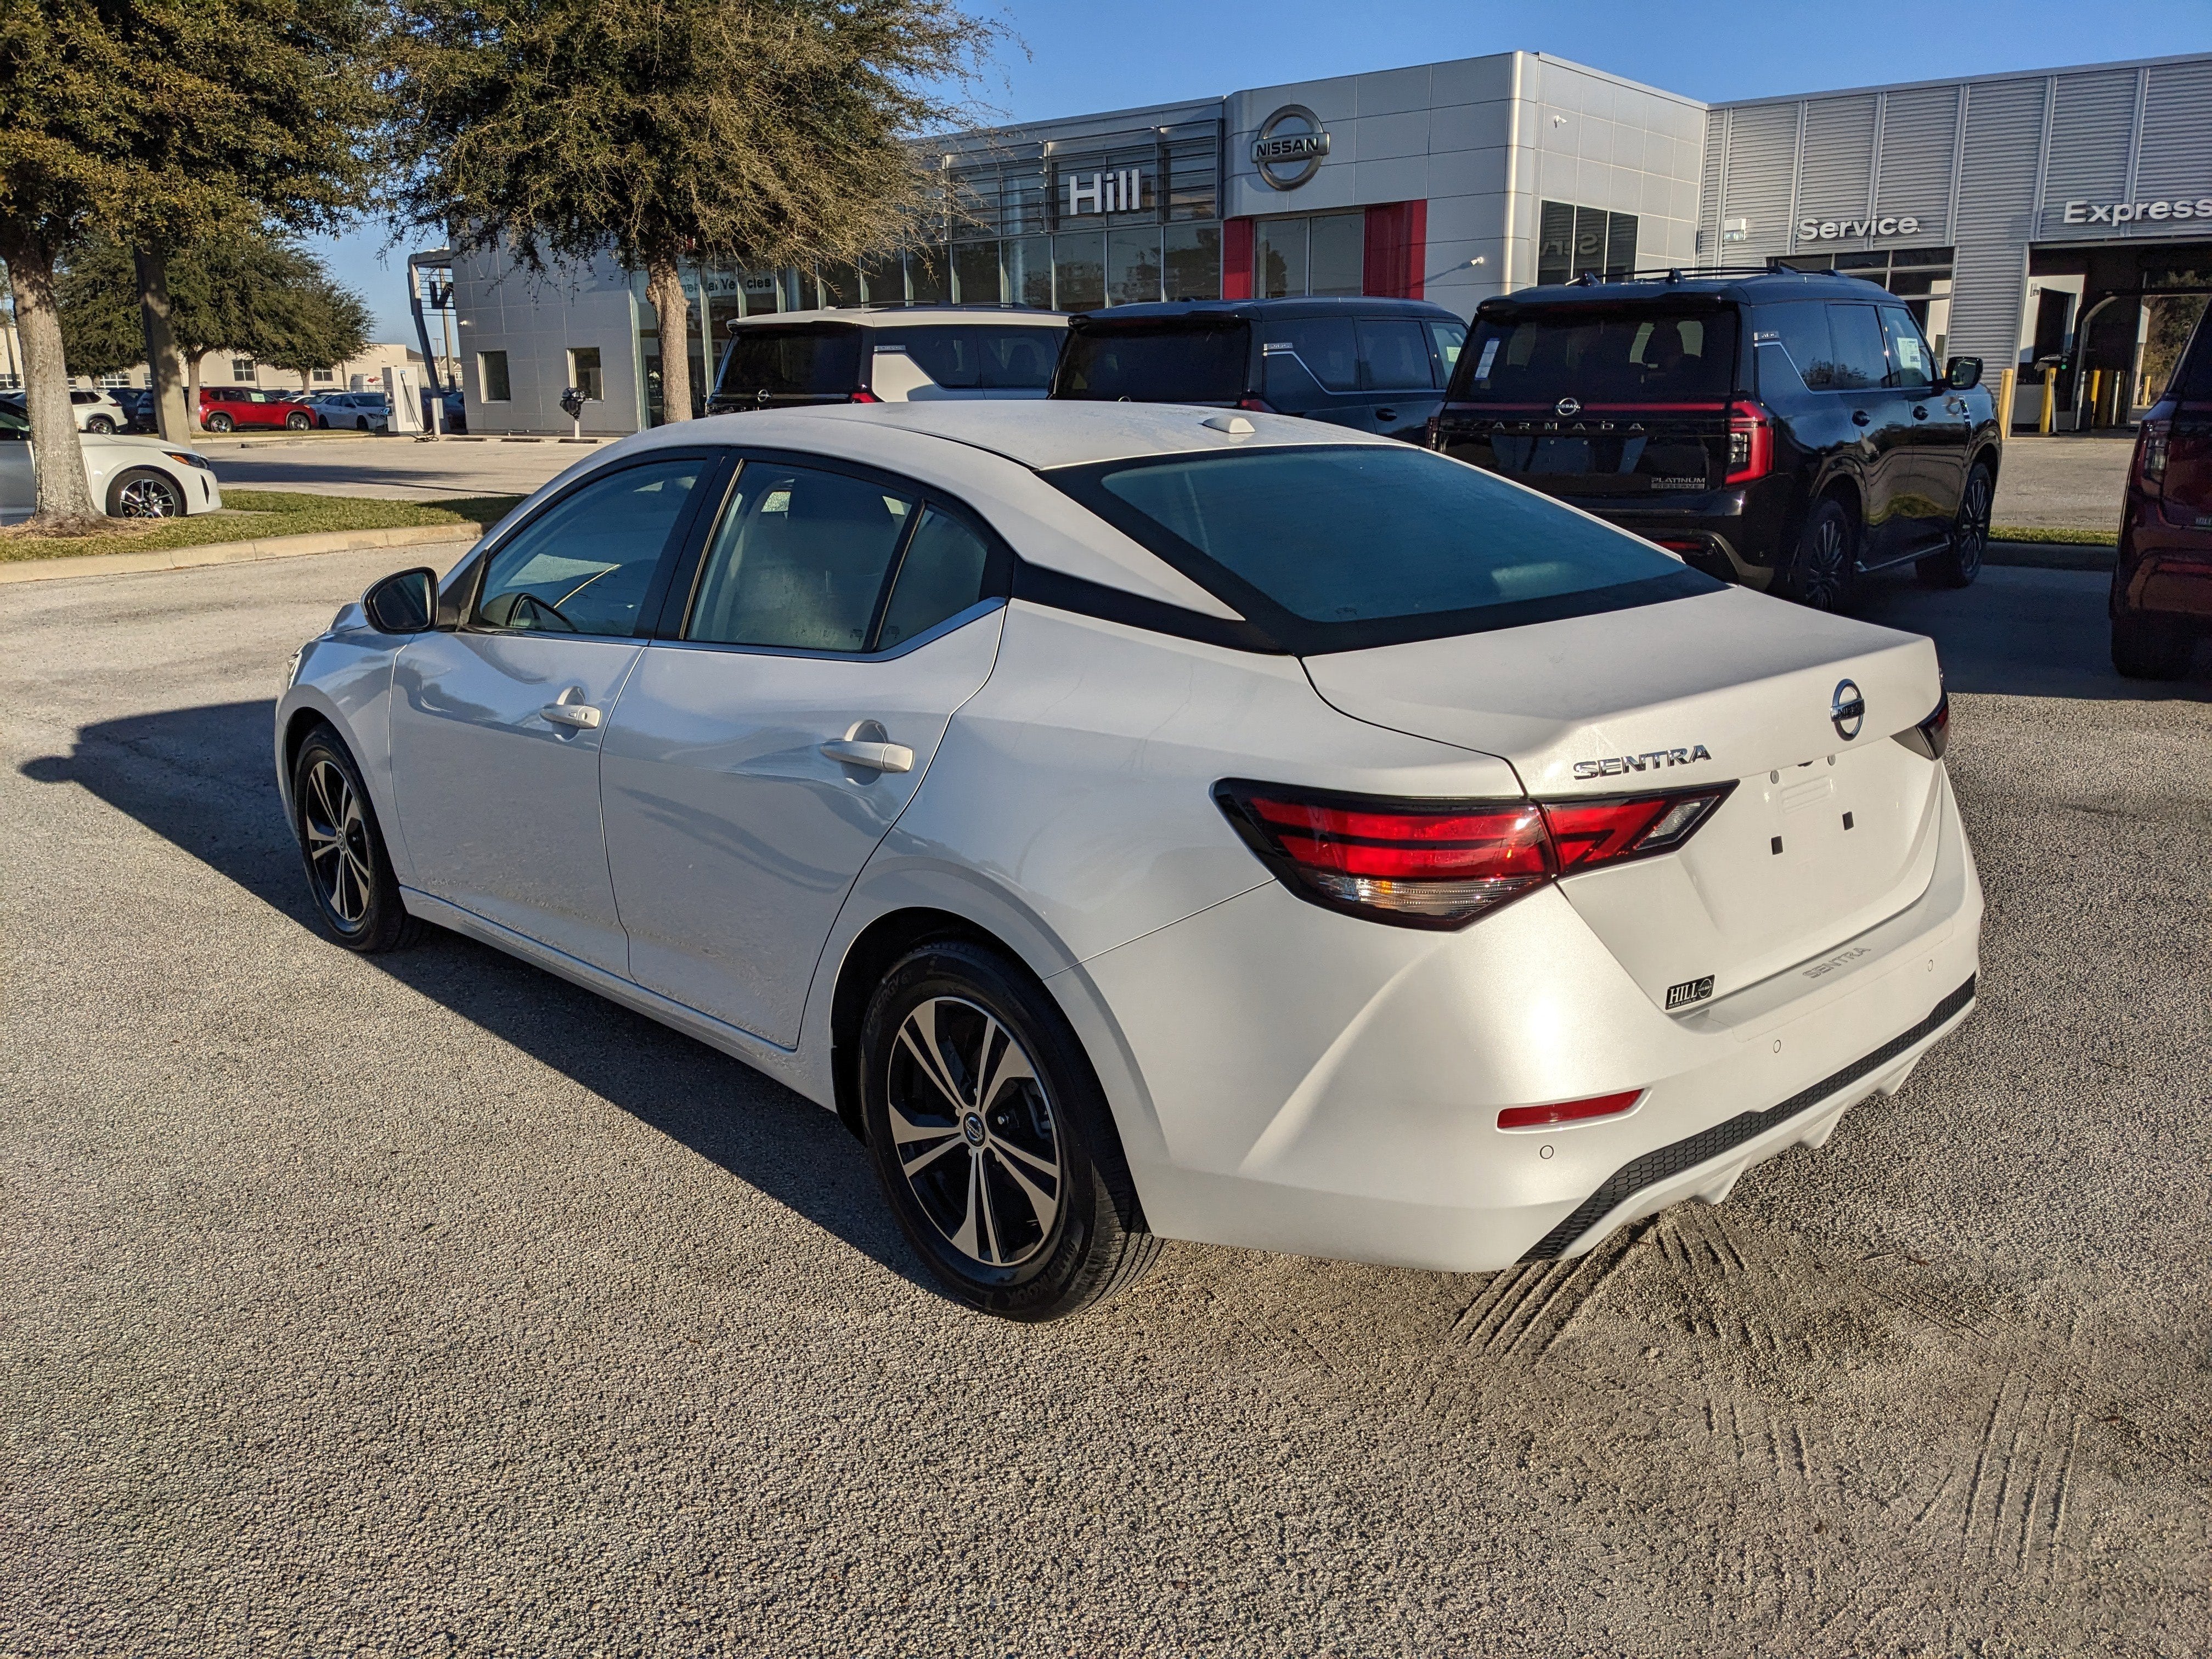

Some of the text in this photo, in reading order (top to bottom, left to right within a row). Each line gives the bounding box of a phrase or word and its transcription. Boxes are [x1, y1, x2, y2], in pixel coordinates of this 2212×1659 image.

[1256, 137, 1319, 157] NISSAN
[1069, 168, 1140, 215] Hill
[2063, 199, 2212, 227] Express
[1797, 216, 1918, 240] Service
[1492, 421, 1644, 431] ARMADA
[1573, 744, 1712, 780] SENTRA
[1802, 947, 1872, 979] SENTRA
[1668, 982, 1697, 1005] HILL
